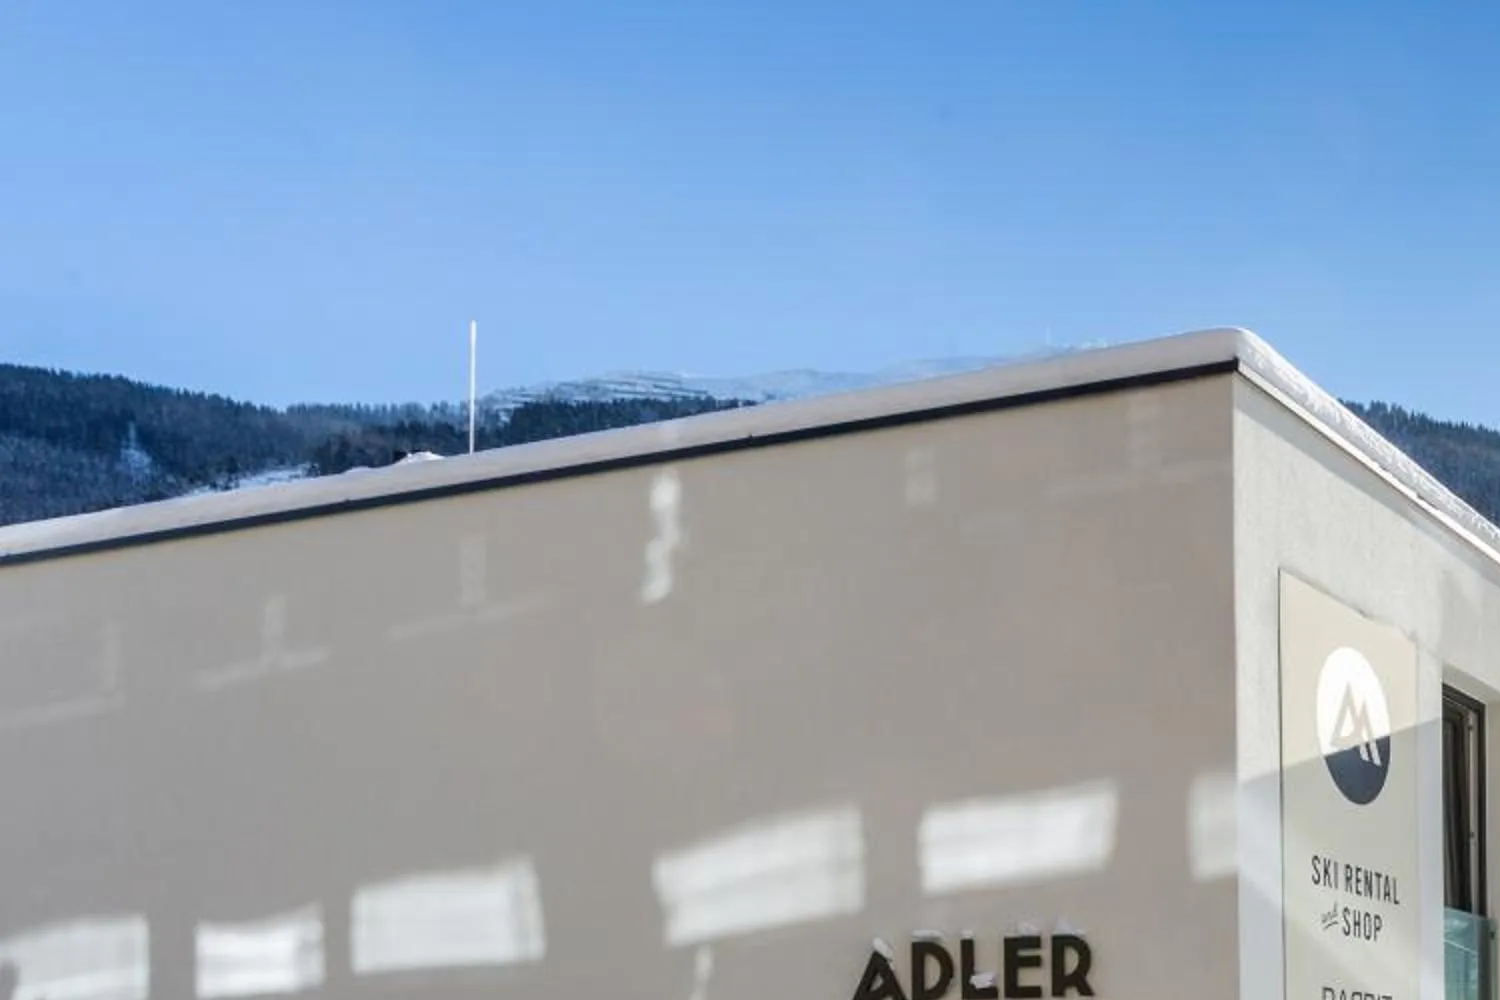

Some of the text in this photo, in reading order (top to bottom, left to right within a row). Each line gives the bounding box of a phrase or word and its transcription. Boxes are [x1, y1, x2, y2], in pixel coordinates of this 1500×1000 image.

[1311, 855, 1400, 905] SKI RENTAL
[1343, 906, 1383, 941] SHOP
